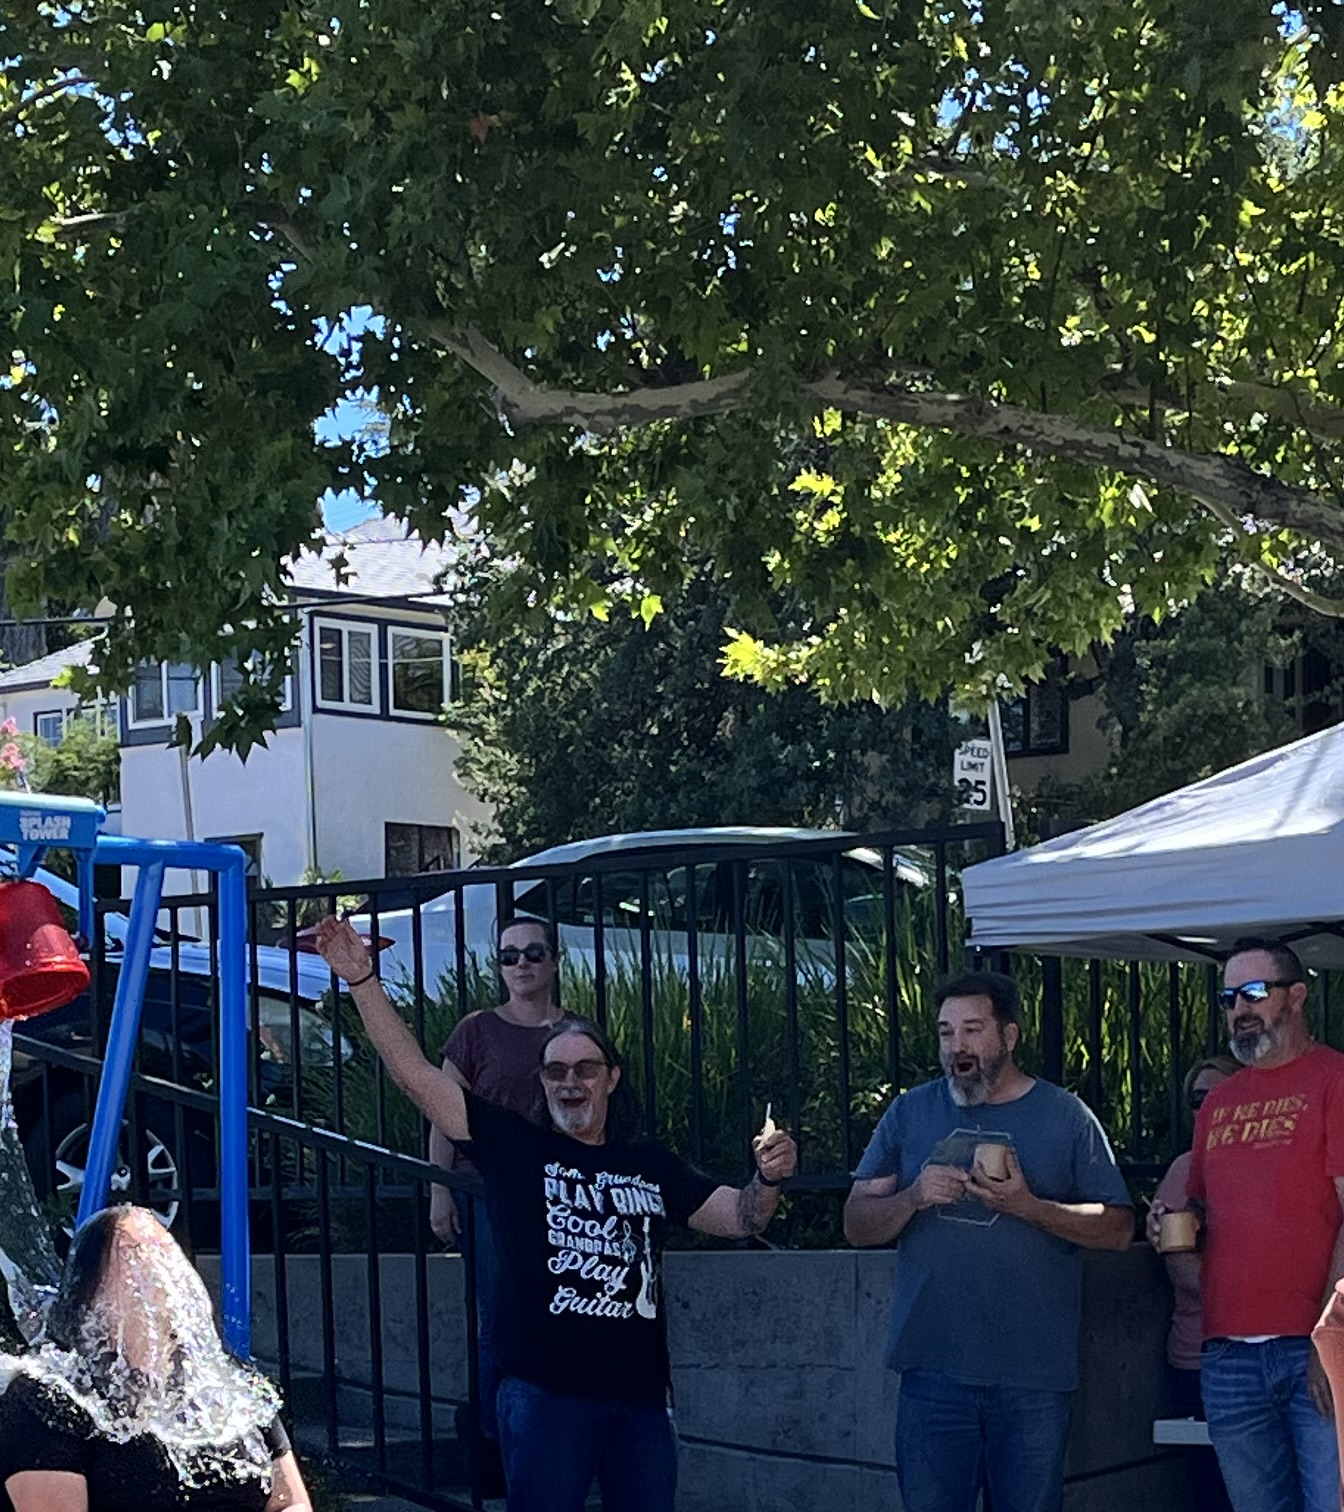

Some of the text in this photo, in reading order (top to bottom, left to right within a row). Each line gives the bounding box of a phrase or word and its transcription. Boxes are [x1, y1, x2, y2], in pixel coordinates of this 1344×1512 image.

[960, 760, 985, 773] LIMIT
[19, 815, 71, 829] SPLASH
[21, 827, 70, 841] TOWER
[544, 1177, 605, 1214] PLAY
[546, 1200, 619, 1240] Cool
[547, 1229, 622, 1257] GRANDPAS
[548, 1249, 630, 1295] Play
[549, 1285, 635, 1319] Guitar
